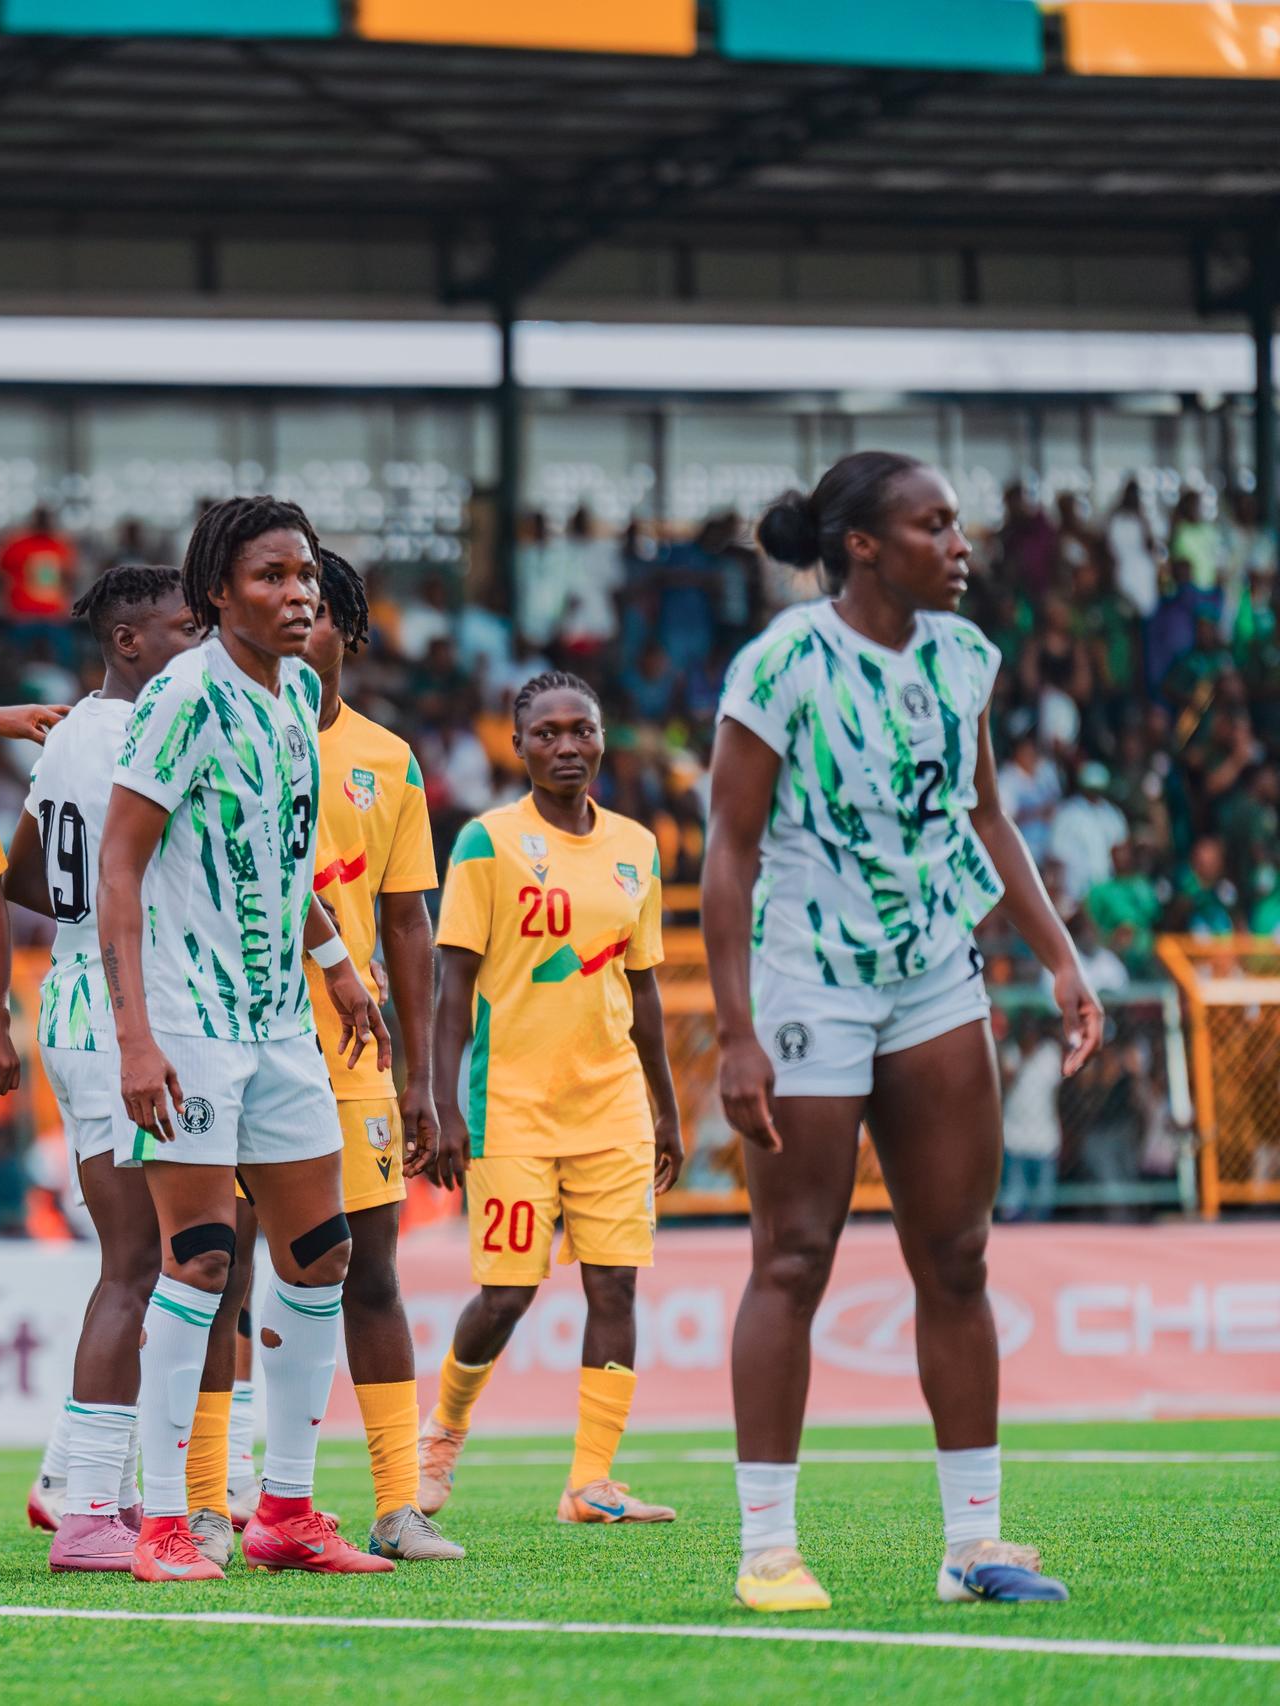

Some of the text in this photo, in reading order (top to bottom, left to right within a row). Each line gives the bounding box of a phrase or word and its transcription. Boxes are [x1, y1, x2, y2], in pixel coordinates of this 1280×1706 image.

[915, 760, 948, 820] 2
[292, 794, 312, 860] 3
[38, 799, 91, 924] 19
[518, 886, 572, 938] 20
[482, 1198, 535, 1254] 20
